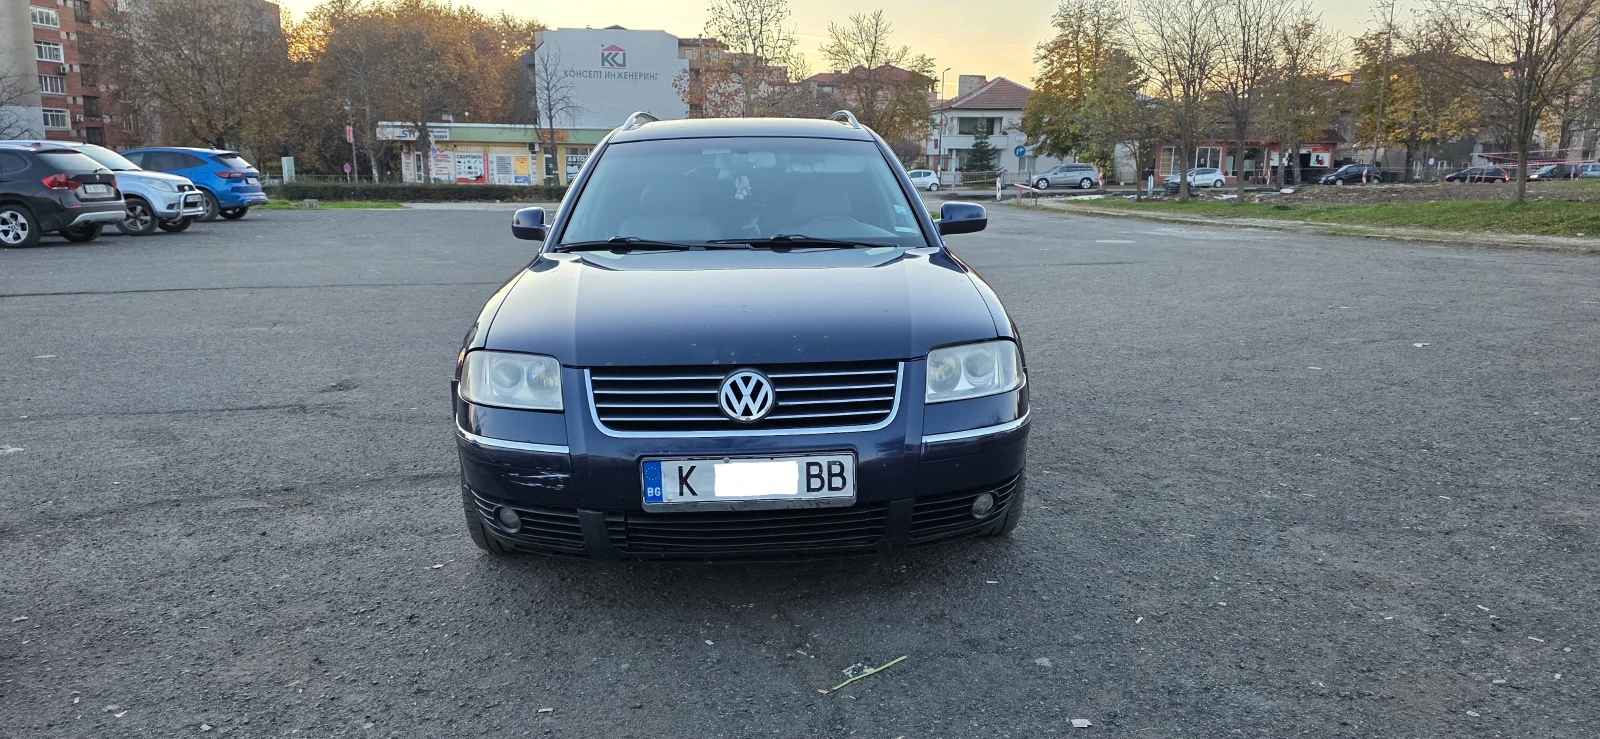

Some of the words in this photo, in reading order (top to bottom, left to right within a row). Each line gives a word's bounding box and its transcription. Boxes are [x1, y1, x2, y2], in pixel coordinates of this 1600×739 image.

[563, 69, 602, 79] КОНСЕПТ
[604, 71, 659, 81] ИНЖЕНЕРИНГ
[720, 371, 773, 421] VW
[677, 465, 698, 497] K
[805, 460, 847, 493] BB
[647, 486, 661, 497] BG
